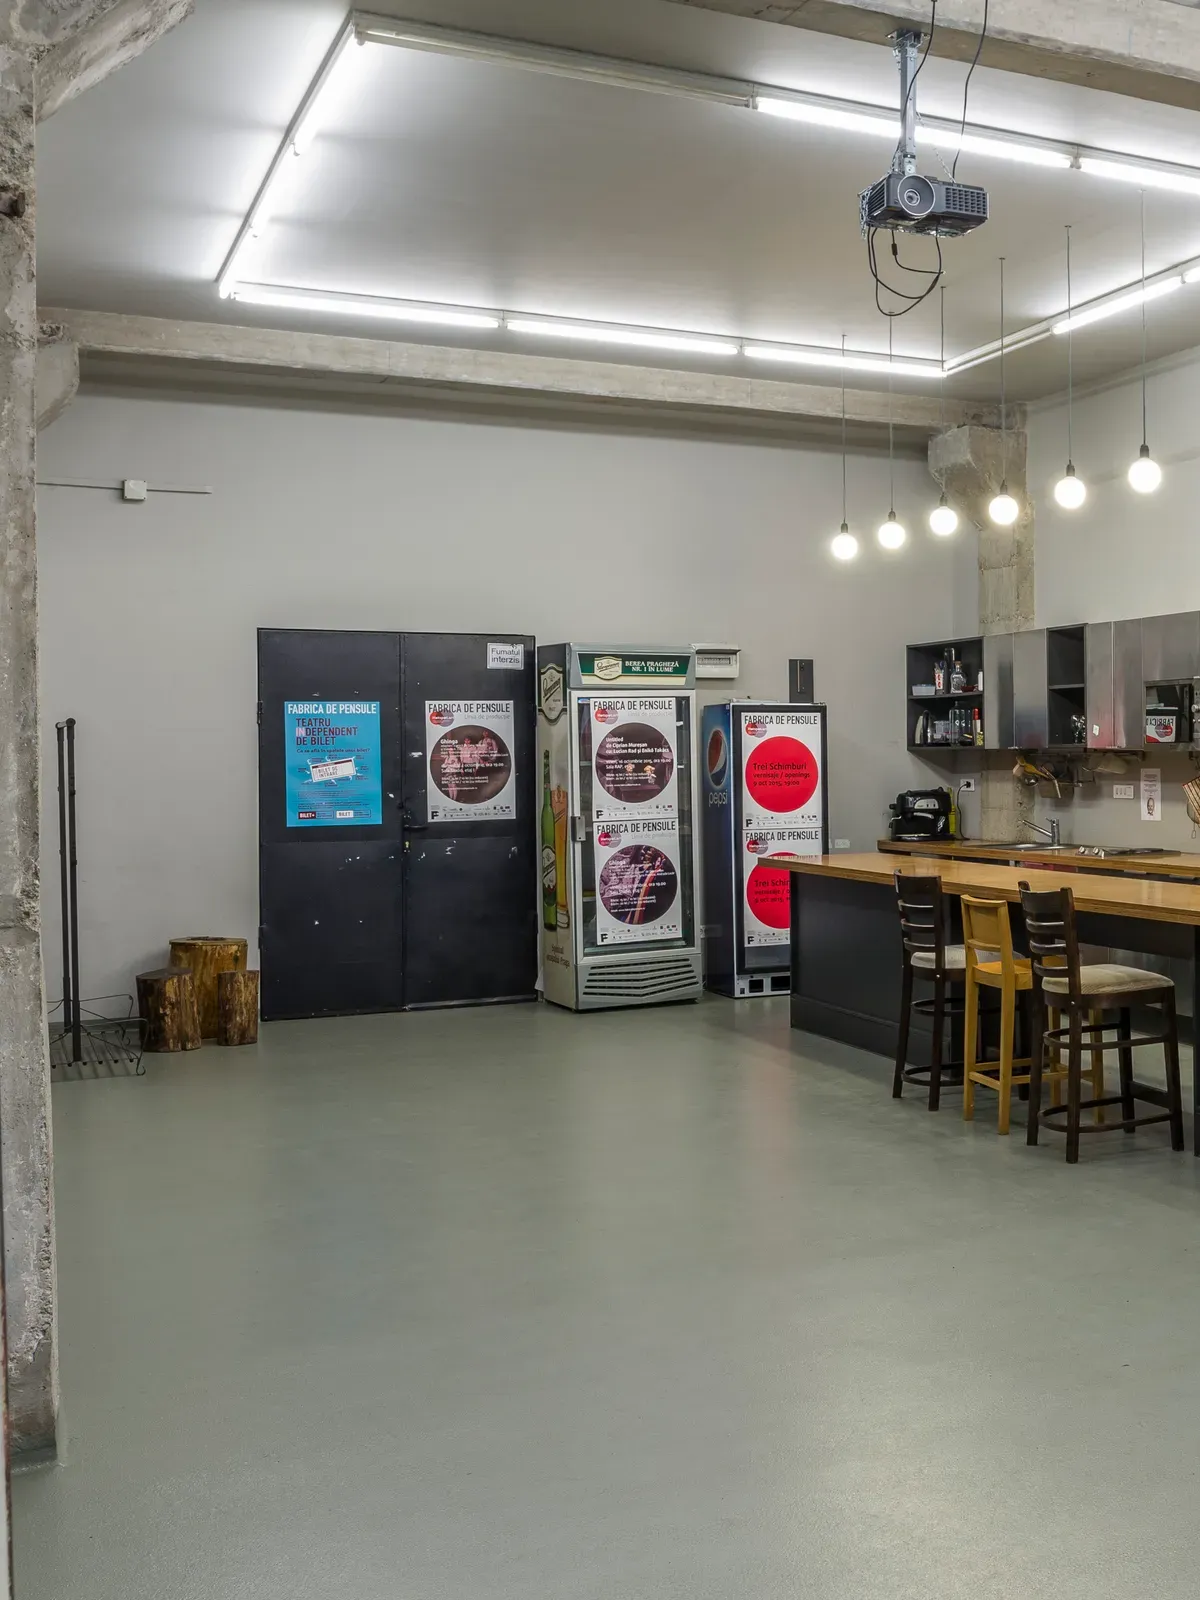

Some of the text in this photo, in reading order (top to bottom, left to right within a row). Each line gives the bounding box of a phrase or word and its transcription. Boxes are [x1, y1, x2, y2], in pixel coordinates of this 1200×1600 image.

[288, 704, 376, 714] FABRICA DE PENSULE
[429, 703, 510, 713] FABRICA DE PENSULE
[594, 700, 672, 710] FABRICA DE PENSULE
[296, 718, 330, 727] TEATRU
[745, 716, 818, 724] FABRICA DE PENSULE
[296, 727, 358, 736] INDEPENDENT
[296, 736, 336, 745] DE BILET
[709, 789, 728, 807] pepsi
[597, 821, 675, 834] FABRICA DE PENSULE
[746, 831, 819, 841] FABRICA DE PENSULE
